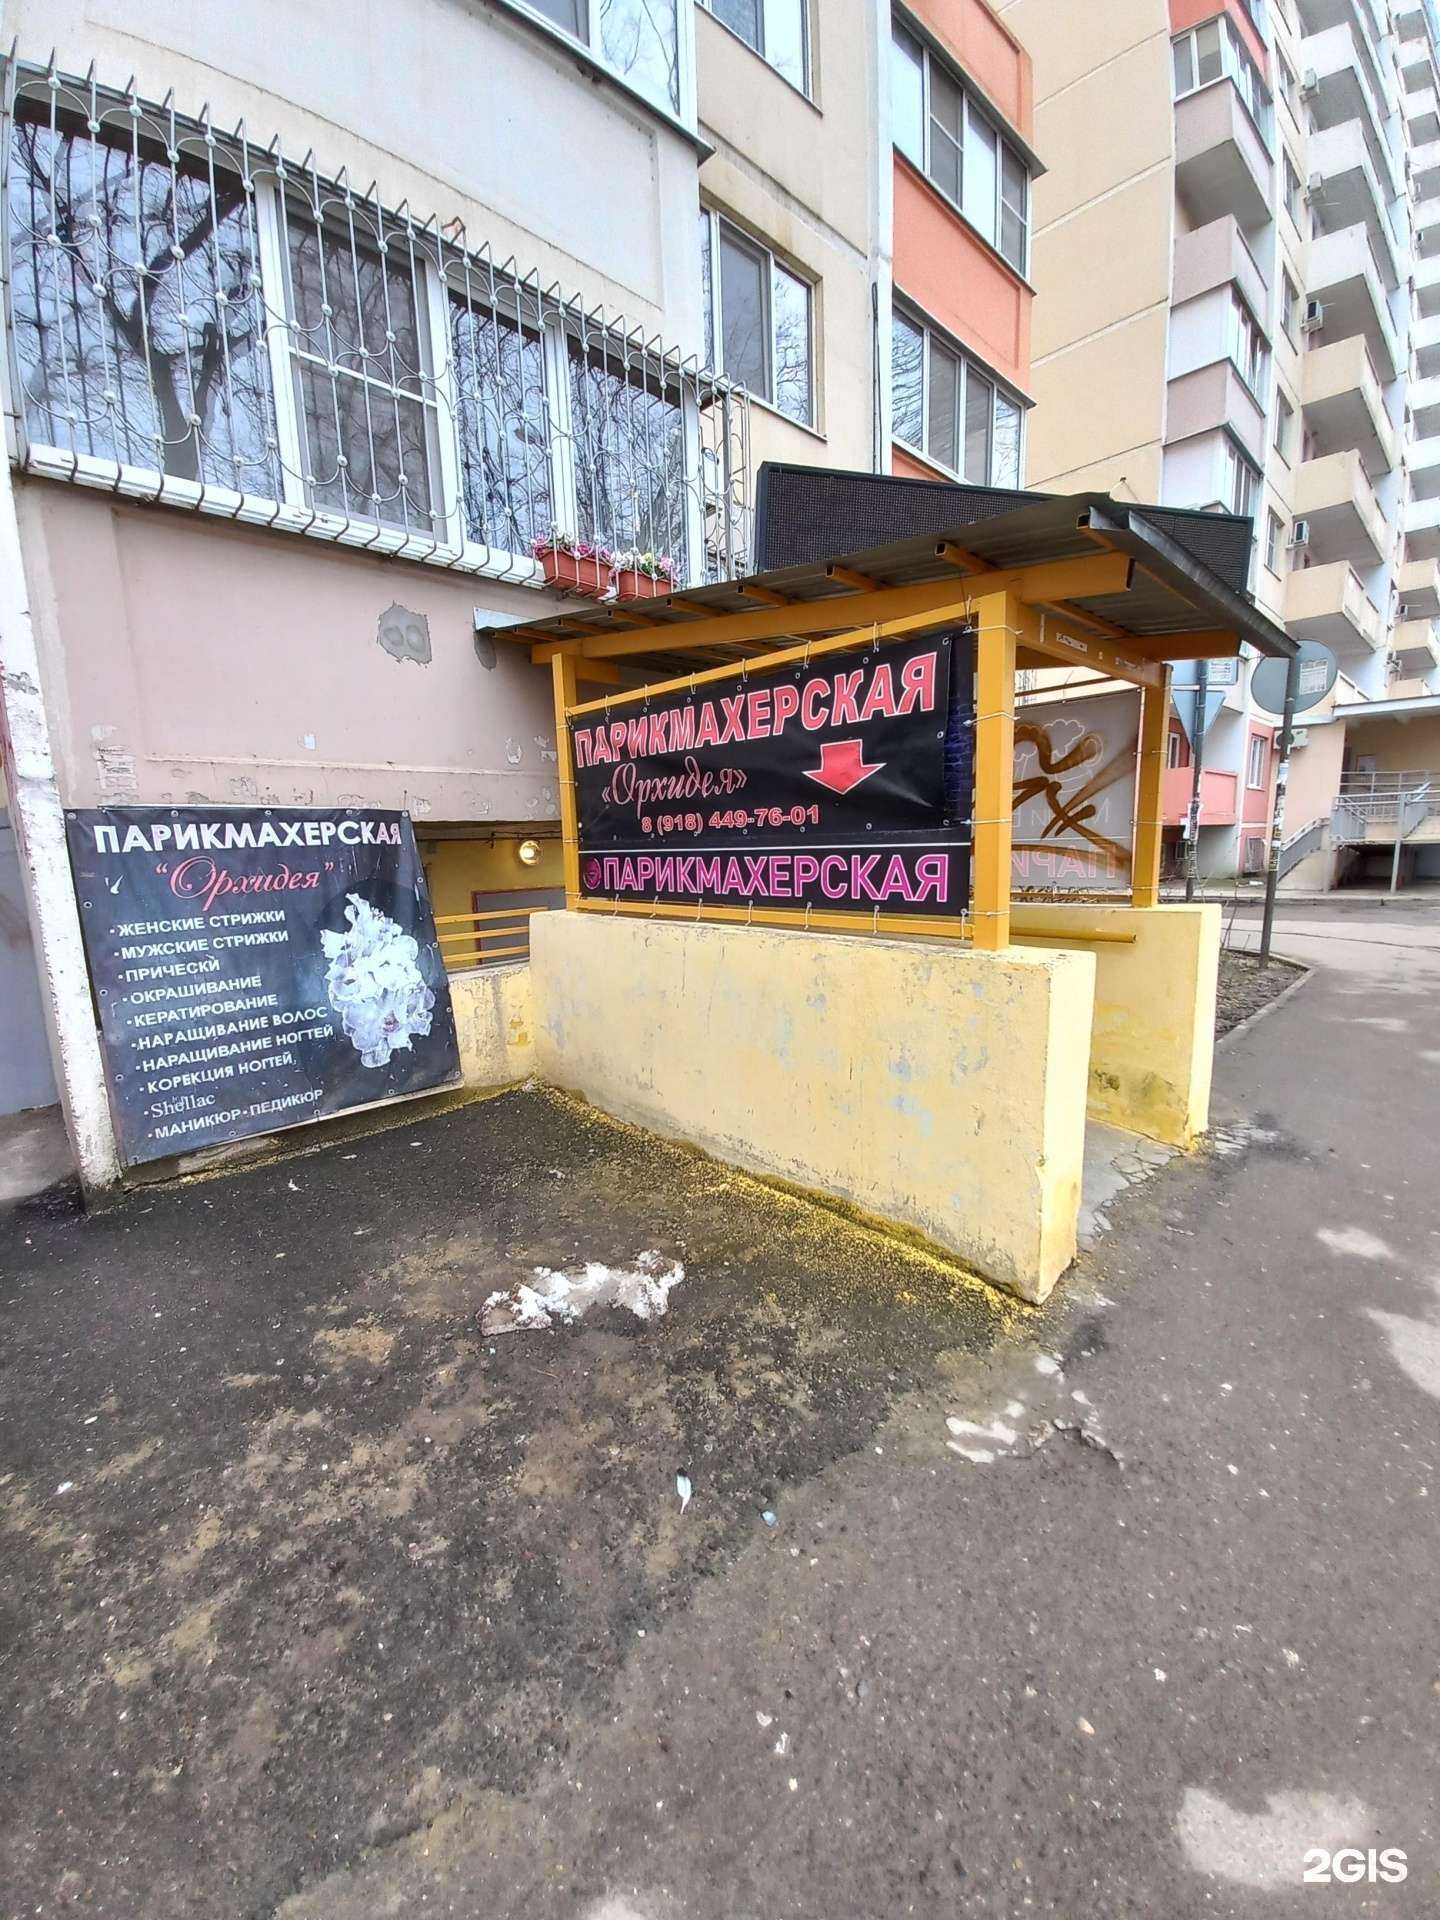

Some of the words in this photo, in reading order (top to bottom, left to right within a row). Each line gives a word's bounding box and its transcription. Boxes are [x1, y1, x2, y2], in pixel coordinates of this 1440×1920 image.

[574, 650, 938, 768] ПАРИКМАХЕРСКАЯ
[641, 816, 653, 833] 8
[656, 813, 704, 835] (918)
[708, 804, 820, 829] 449-76-01
[93, 820, 402, 854] ПАРИКМАХЕРСКАЯ
[603, 853, 949, 902] ПАРИКМАХЕРСКАЯ
[117, 917, 206, 937] ЖЕНСКИЕ
[209, 910, 286, 928] СТРИЖКИ
[121, 938, 210, 960] МУЖСКИЕ
[212, 930, 289, 949] СТРИЖКИ
[130, 975, 263, 1005] ОКРАШИВАНИЕ
[133, 994, 279, 1028] КЕРАТИРОВАНИЕ
[138, 1016, 270, 1051] НАРАЩИВАНИЕ
[271, 1006, 329, 1027] ВОЛОС
[142, 1036, 273, 1073] НАРАЩИВАНИЕ
[275, 1023, 334, 1047] НОГТЕЙ
[147, 1065, 235, 1094] КОРЕКЦИЯ
[237, 1050, 293, 1075] НОГТЕЙ
[150, 1094, 217, 1119] Shellac
